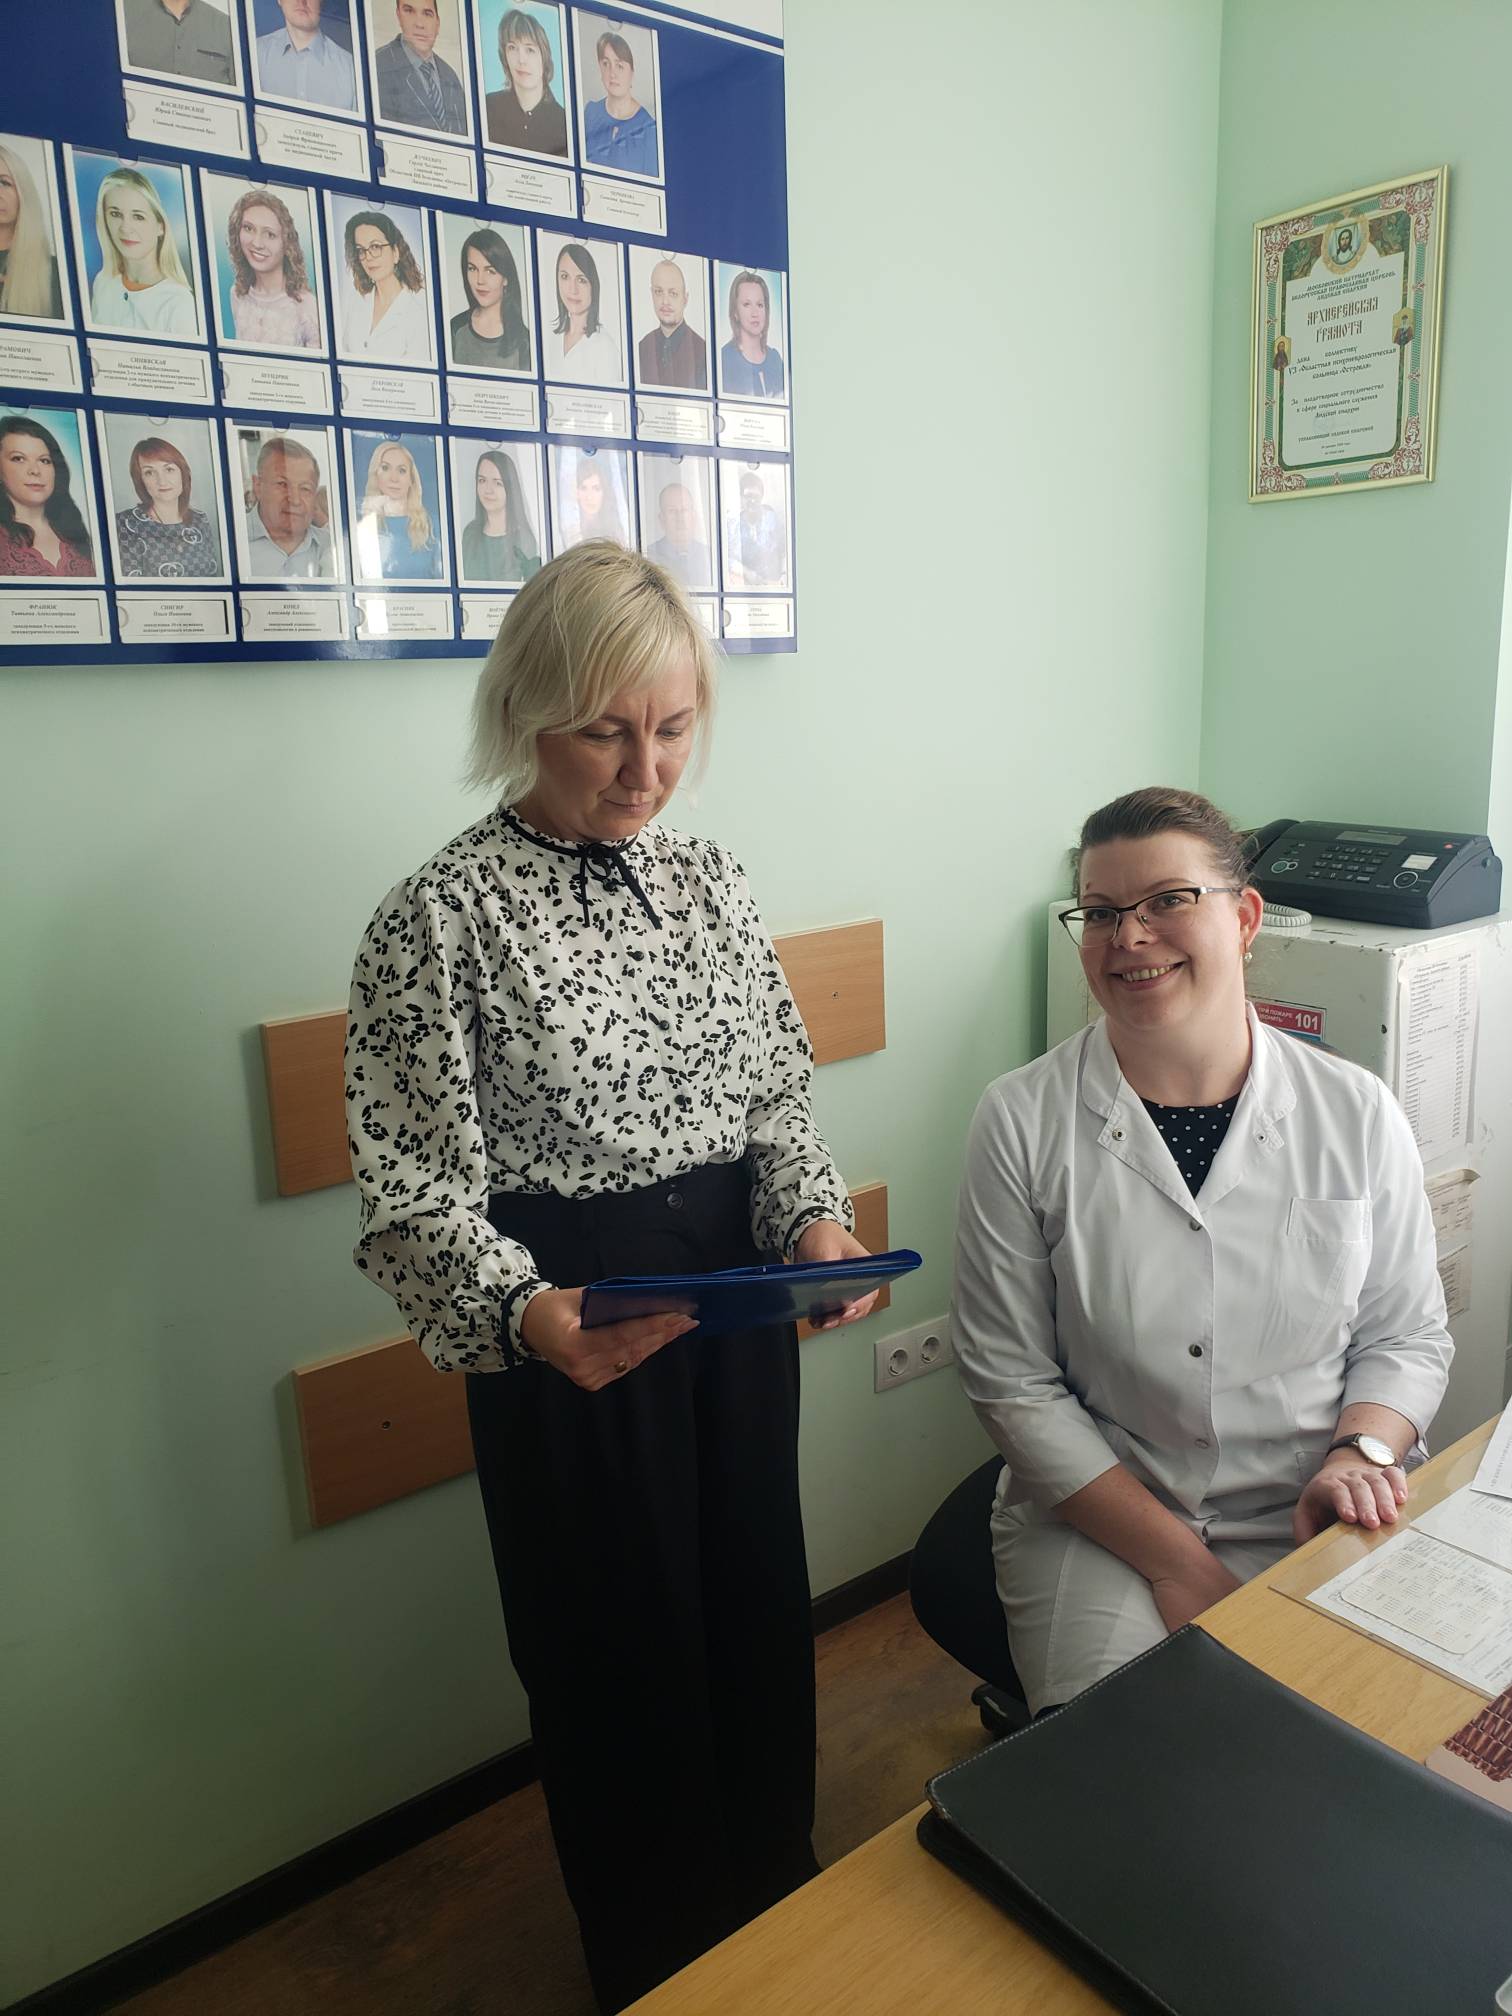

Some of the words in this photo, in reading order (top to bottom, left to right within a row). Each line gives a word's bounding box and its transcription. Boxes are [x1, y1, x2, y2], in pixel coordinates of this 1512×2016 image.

[1307, 296, 1378, 326] АРХИЕРЕЙСКАЯ
[1316, 320, 1362, 343] ГРАМОТА
[1296, 1013, 1318, 1030] 101
